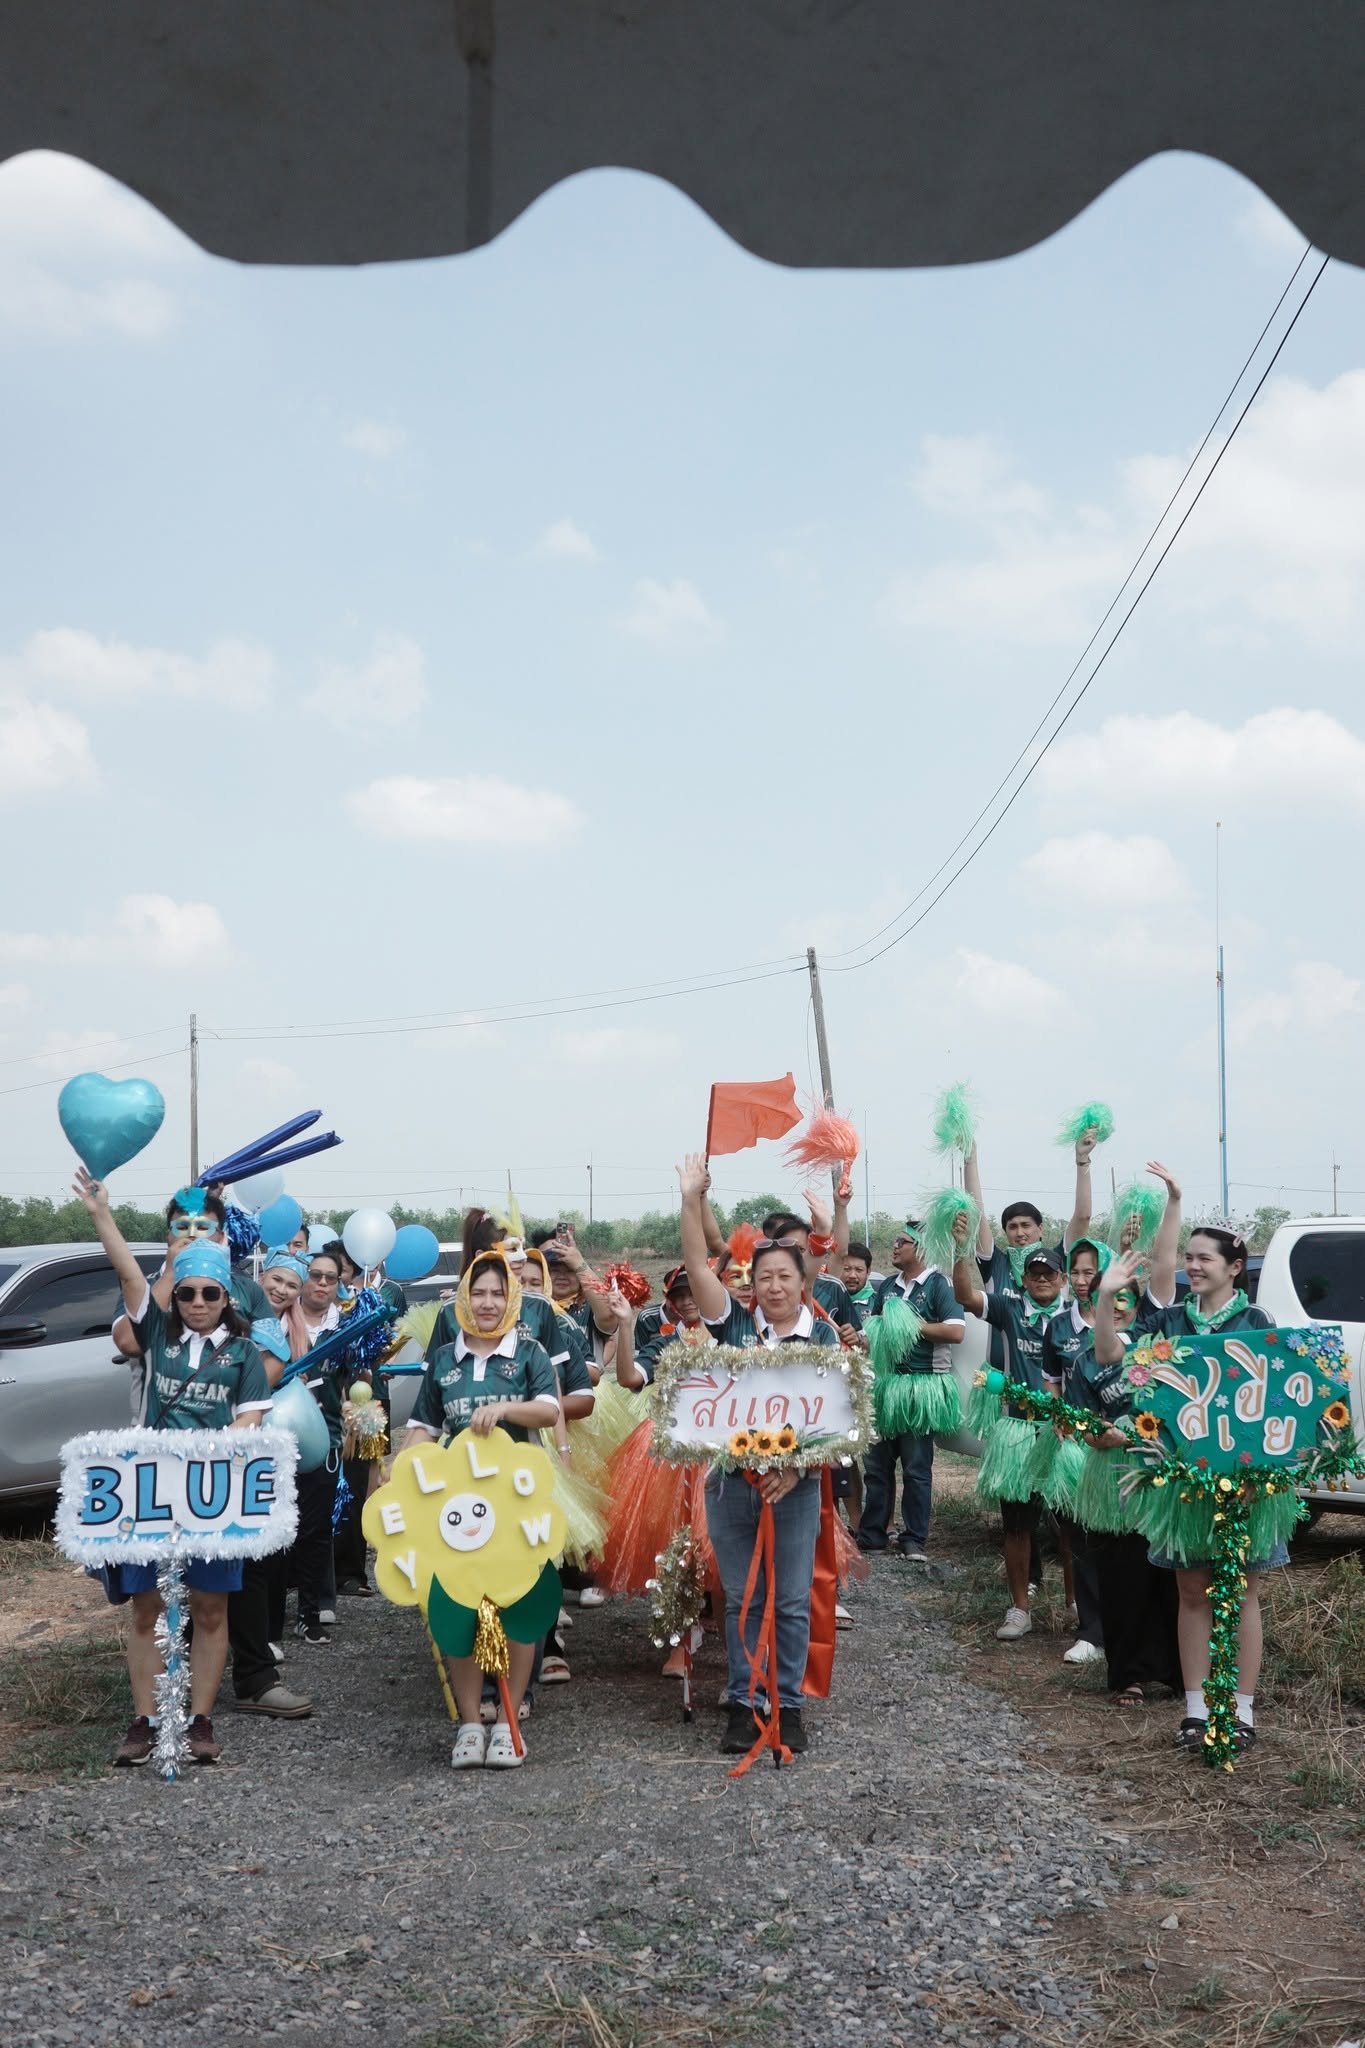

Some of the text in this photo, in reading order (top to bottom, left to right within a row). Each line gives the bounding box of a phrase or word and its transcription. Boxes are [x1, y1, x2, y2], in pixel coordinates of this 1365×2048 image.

[1017, 1338, 1042, 1353] ONE
[184, 1381, 230, 1404] TEAM
[677, 1372, 823, 1428] สีแดง
[79, 1456, 276, 1525] BLUE
[379, 1441, 552, 1589] YELLOW
